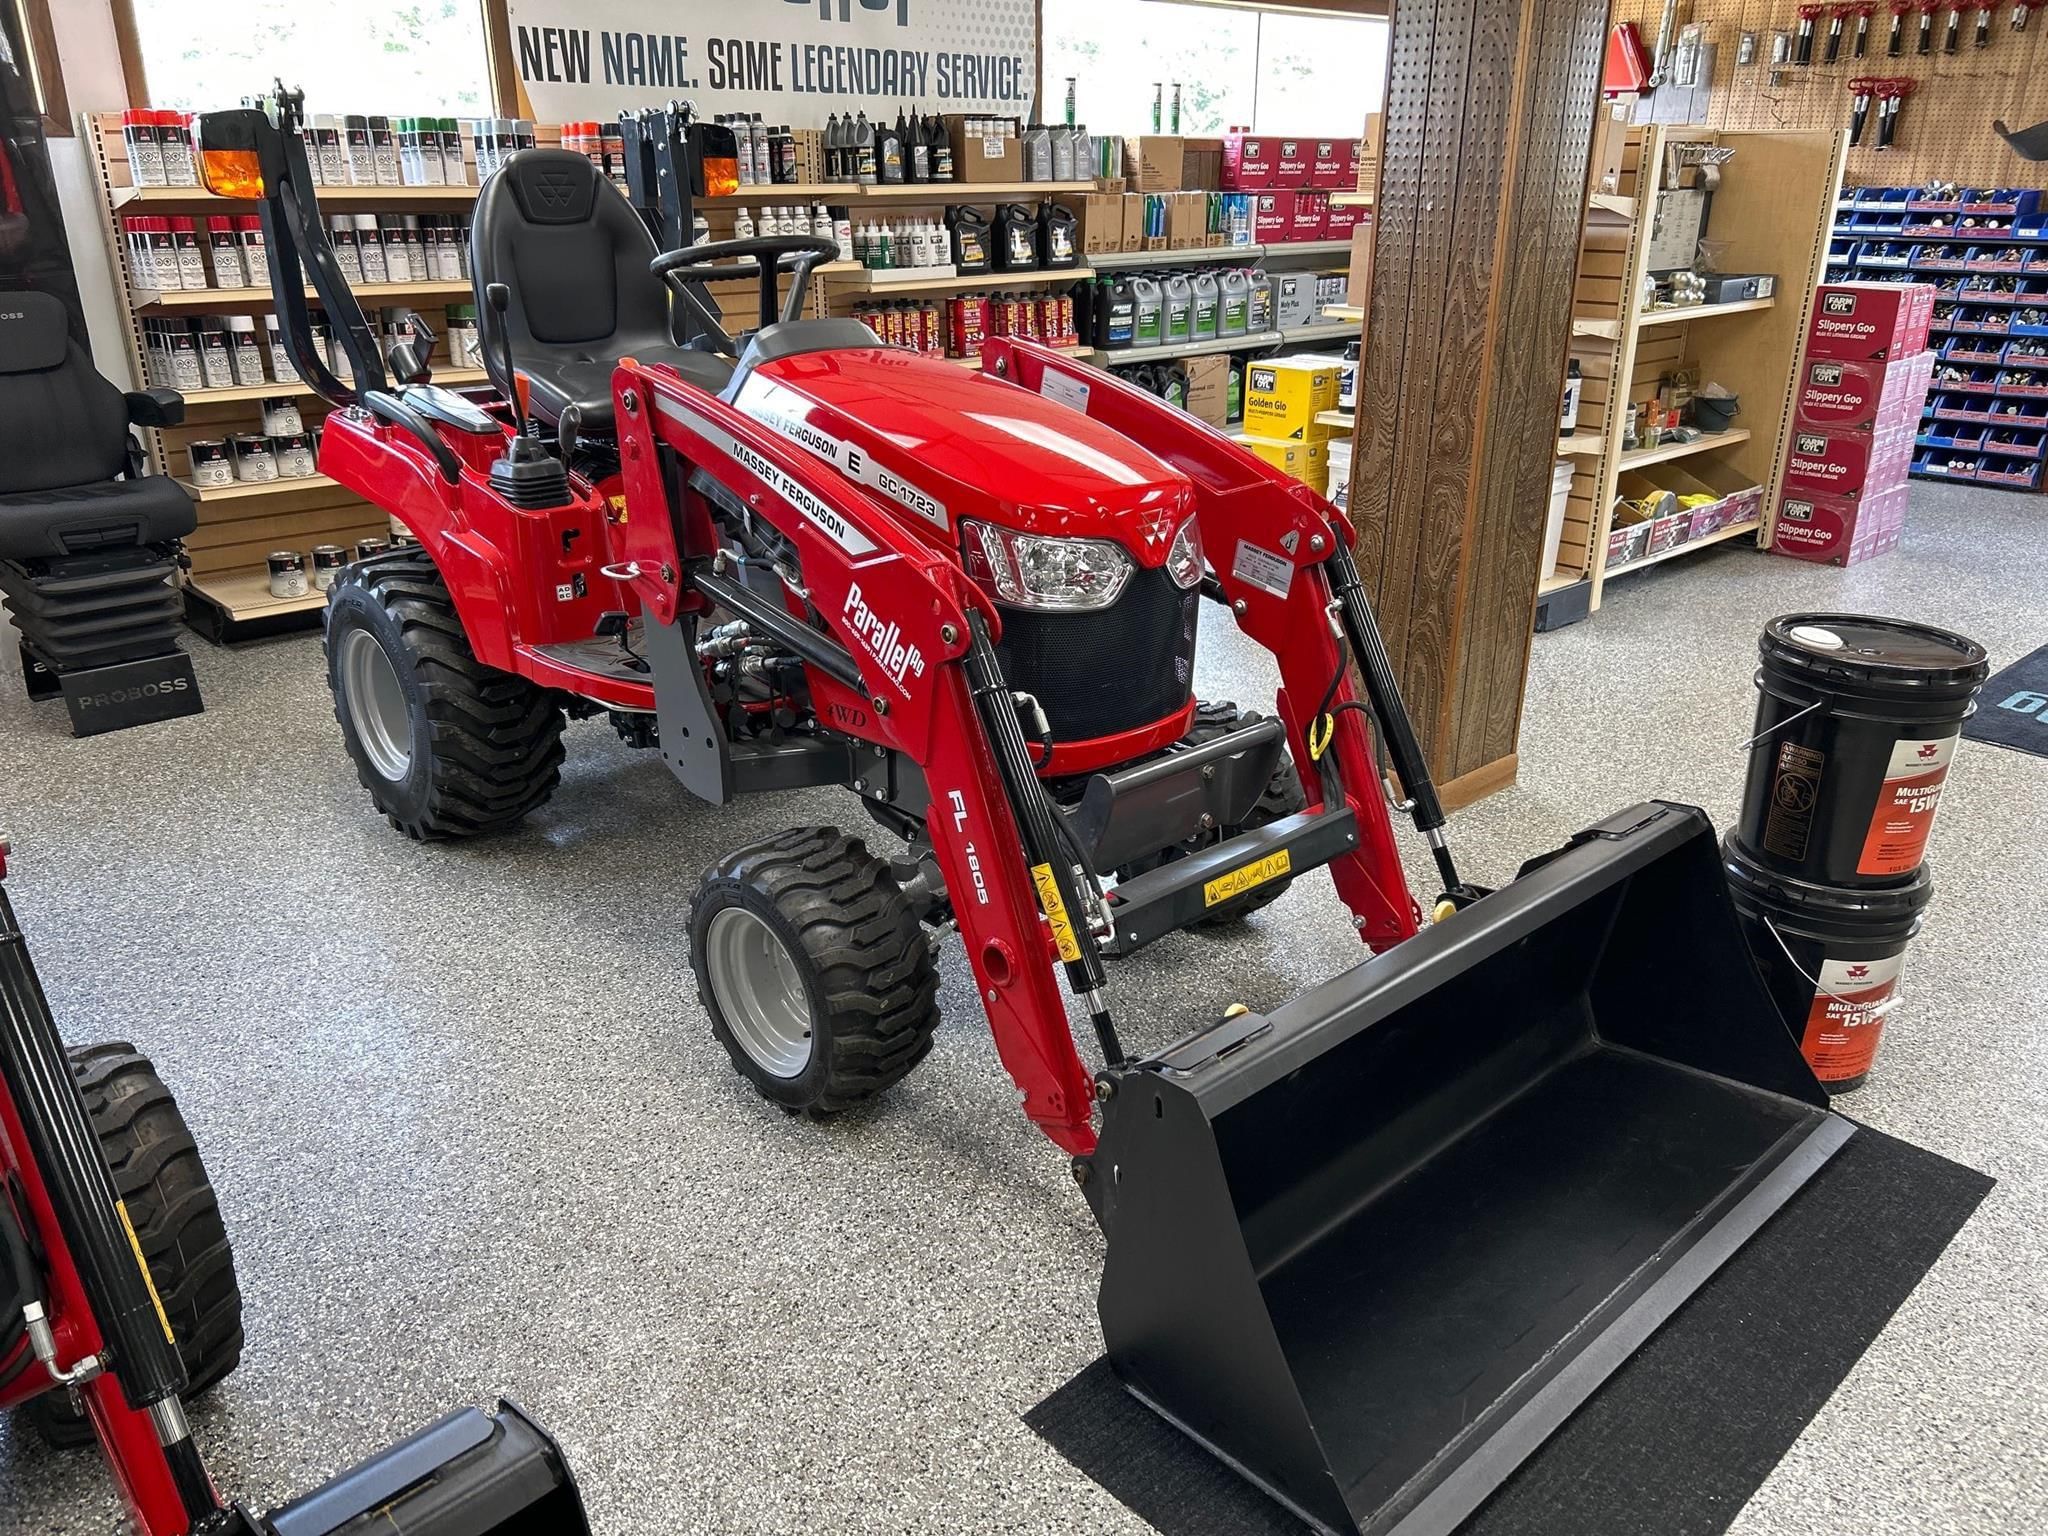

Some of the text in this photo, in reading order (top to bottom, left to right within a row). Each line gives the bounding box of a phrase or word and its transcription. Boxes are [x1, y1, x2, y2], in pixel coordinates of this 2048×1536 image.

[517, 26, 1029, 101] NEW NAME. SAME LEGENDARY SERVICE.
[1828, 296, 1853, 306] FARM
[1830, 303, 1848, 311] OYL
[1817, 319, 1876, 333] Slippery Goo
[1254, 372, 1274, 382] FARM
[1815, 367, 1840, 377] FARM
[1817, 374, 1835, 382] OYL
[1256, 381, 1271, 389] OYL
[1248, 396, 1287, 411] Golden Glo
[1805, 389, 1862, 404] Slippery Goo
[1801, 437, 1825, 447] FARM
[1802, 443, 1820, 452] OYL
[783, 418, 838, 459] FERGUSON
[848, 450, 861, 475] E
[878, 472, 898, 495] GC
[899, 487, 936, 518] 1723
[1791, 458, 1847, 474] Slippery Goo
[732, 443, 845, 539] MASSEY FERGUSON
[1787, 503, 1811, 512] FARM
[1789, 509, 1806, 517] OYL
[1778, 522, 1832, 539] Slippery Goo
[843, 581, 914, 682] Parallel
[77, 677, 189, 710] PROBOSS
[826, 701, 868, 728] 4WD
[948, 790, 990, 905] FL 1805
